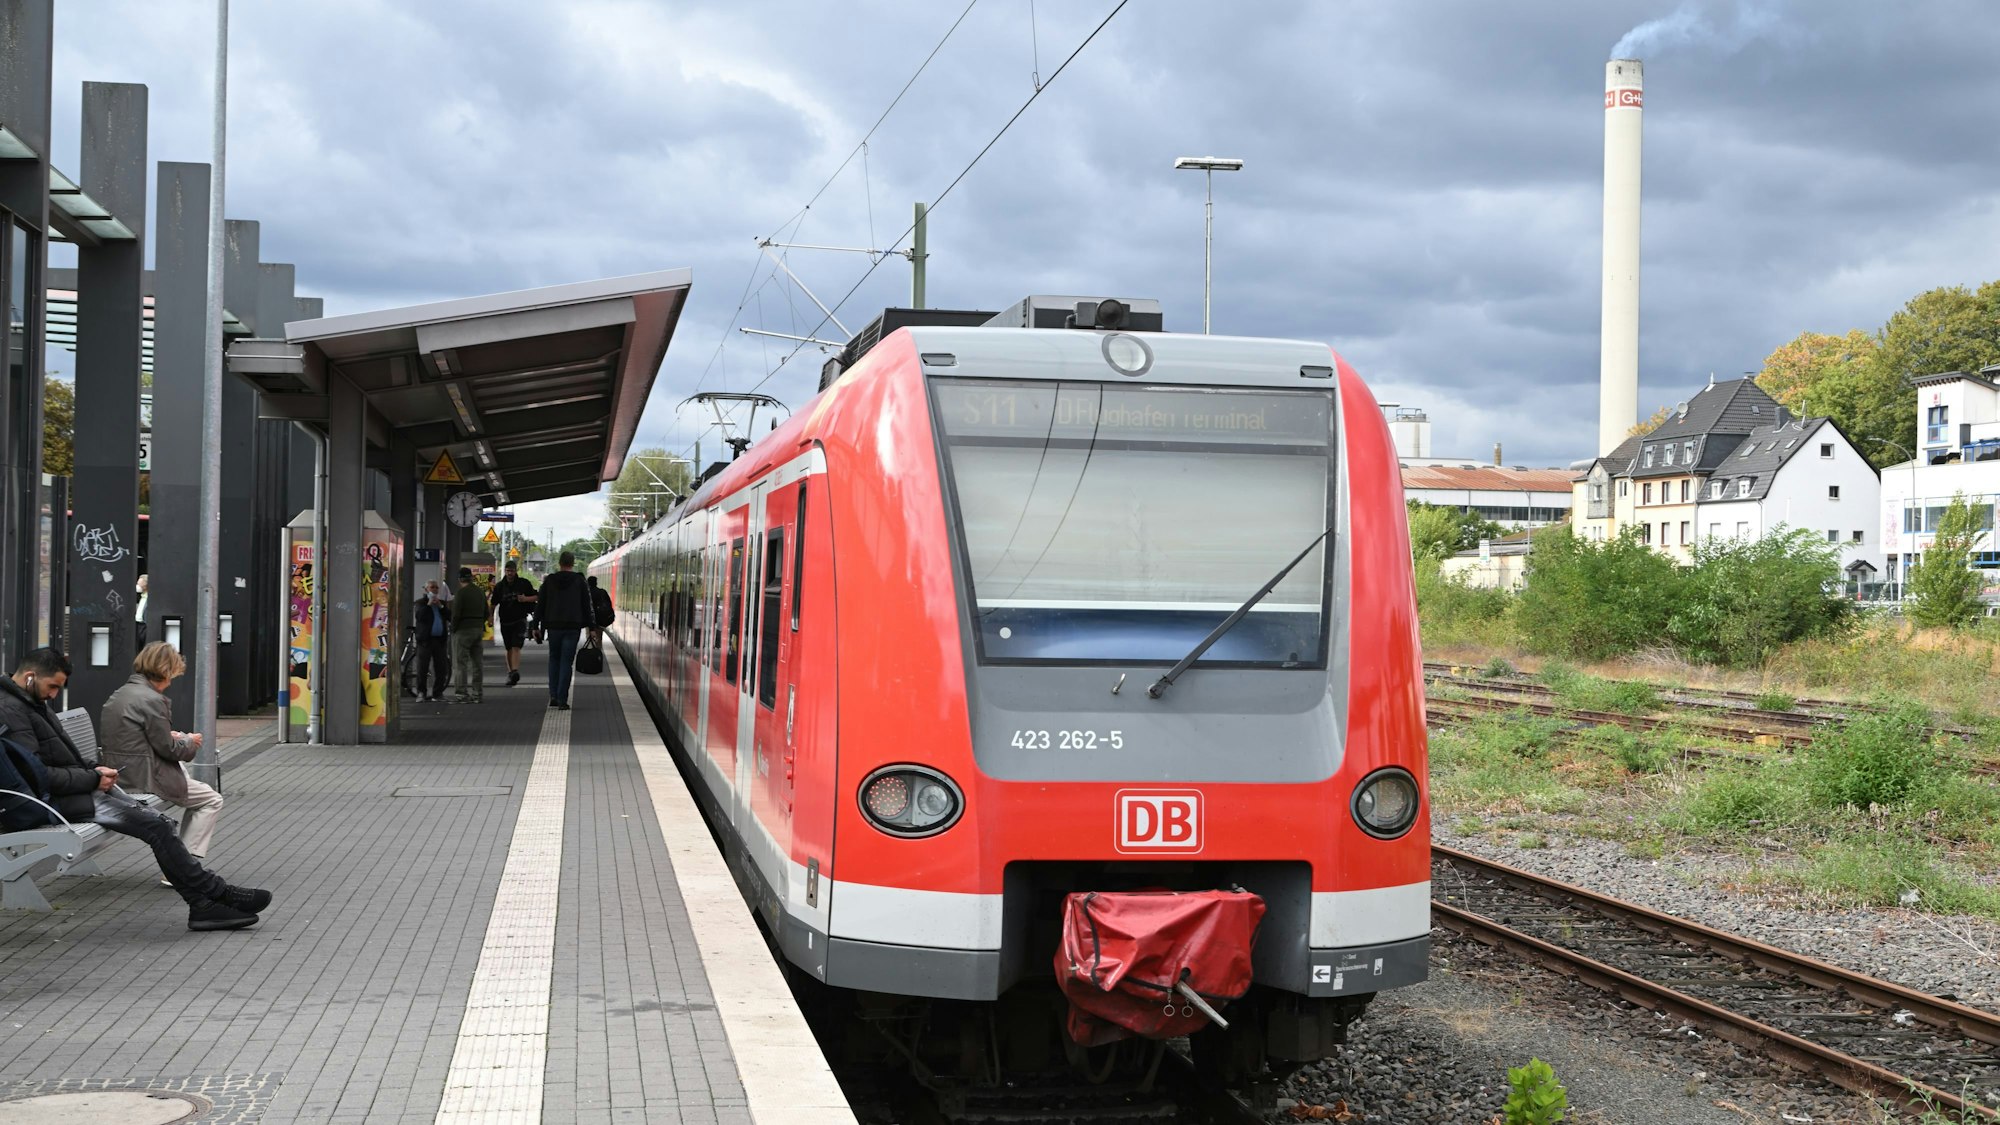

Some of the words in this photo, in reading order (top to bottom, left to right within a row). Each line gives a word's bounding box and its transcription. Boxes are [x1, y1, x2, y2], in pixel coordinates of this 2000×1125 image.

[963, 393, 1016, 425] S11
[1011, 730, 1050, 749] 423
[1058, 730, 1124, 749] 262-5
[1127, 800, 1192, 842] DB
